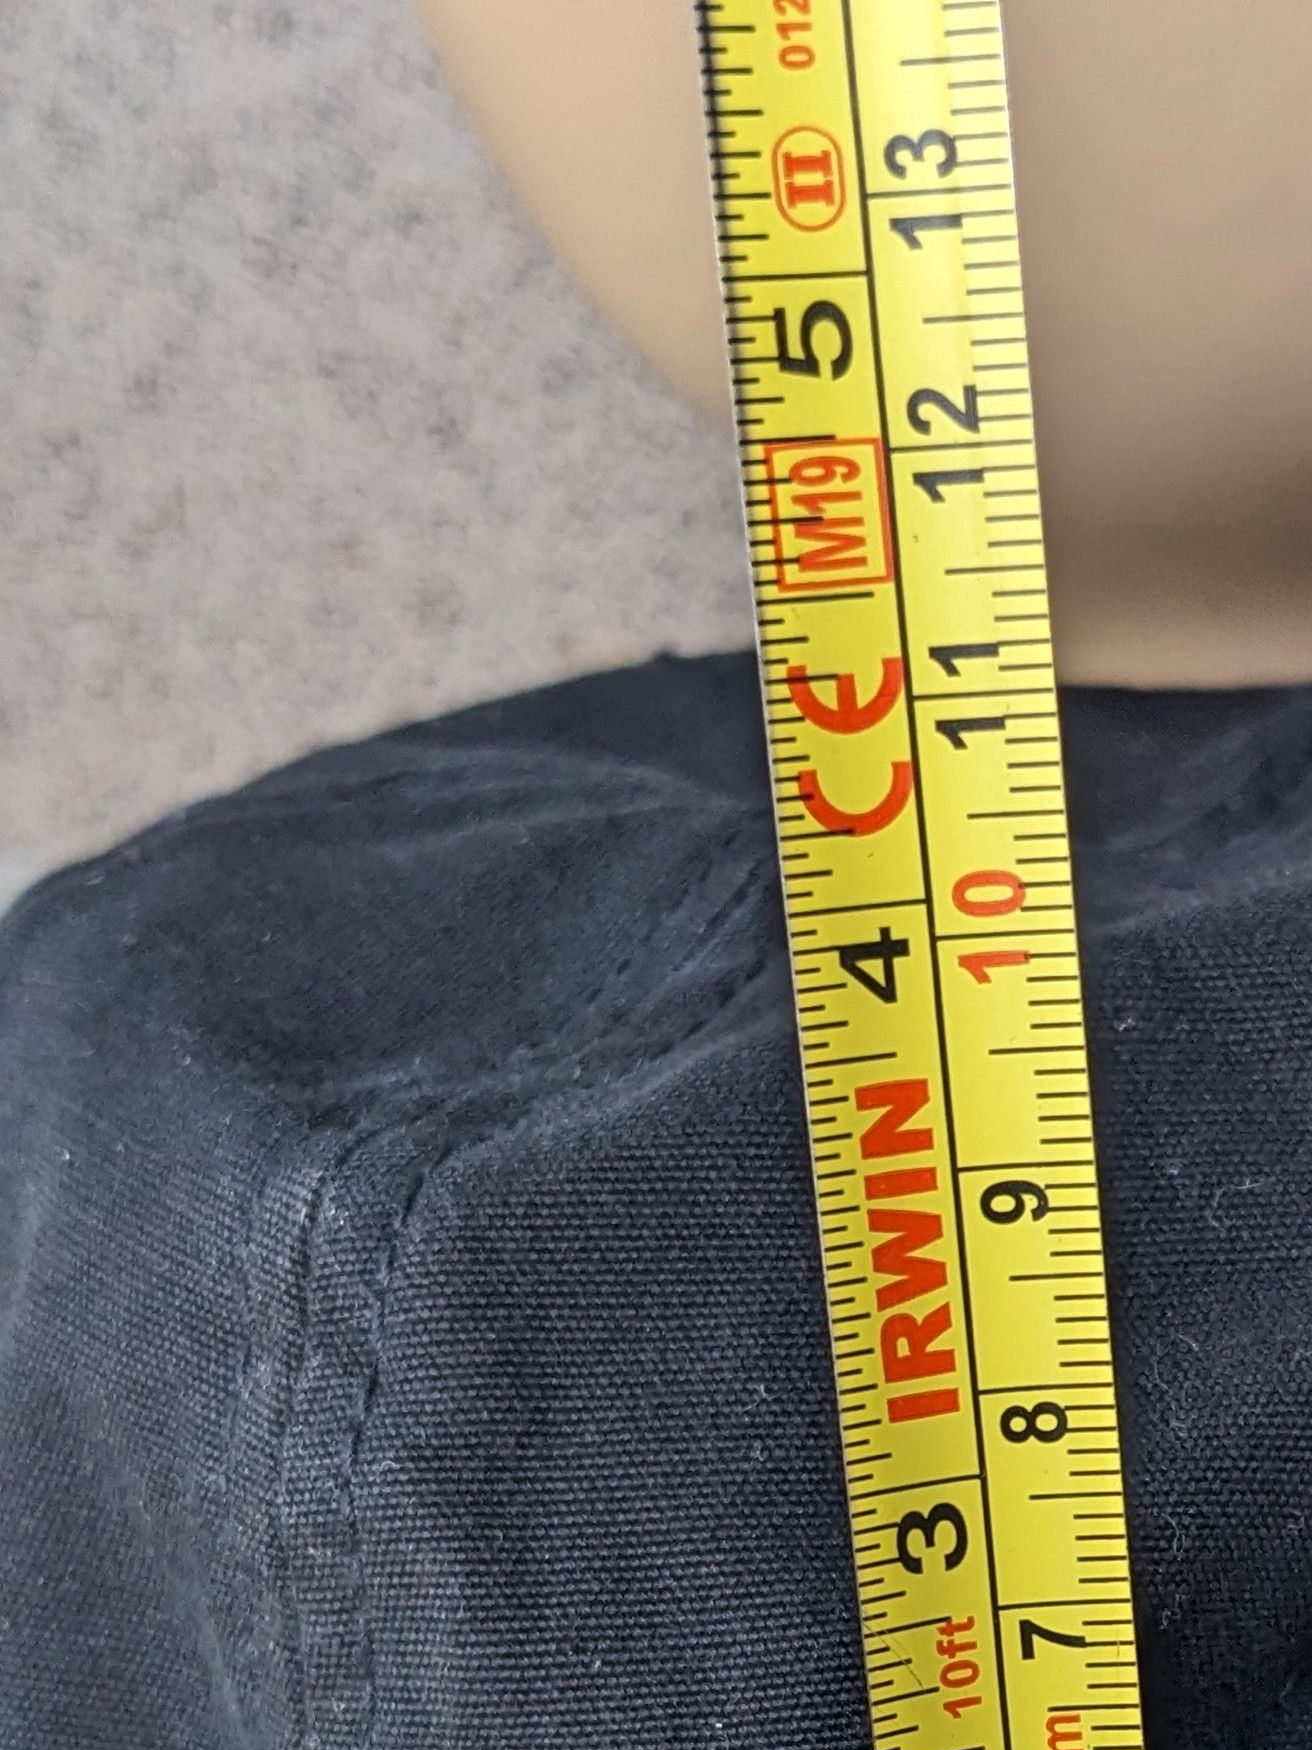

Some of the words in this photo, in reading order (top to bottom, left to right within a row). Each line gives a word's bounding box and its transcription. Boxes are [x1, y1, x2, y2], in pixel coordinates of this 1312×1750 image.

[884, 129, 964, 251] 13
[774, 300, 853, 380] 5
[906, 384, 985, 504] 12
[787, 455, 868, 573] M19
[786, 656, 914, 838] CE
[929, 643, 1006, 751] 11
[839, 926, 911, 1004] 4
[952, 869, 1031, 985] 10
[854, 1078, 961, 1424] IRWIN
[980, 1179, 1049, 1225] 9
[1000, 1401, 1068, 1444] 8
[897, 1502, 968, 1576] 3
[936, 1615, 982, 1720] 10ft
[1018, 1618, 1087, 1661] 7
